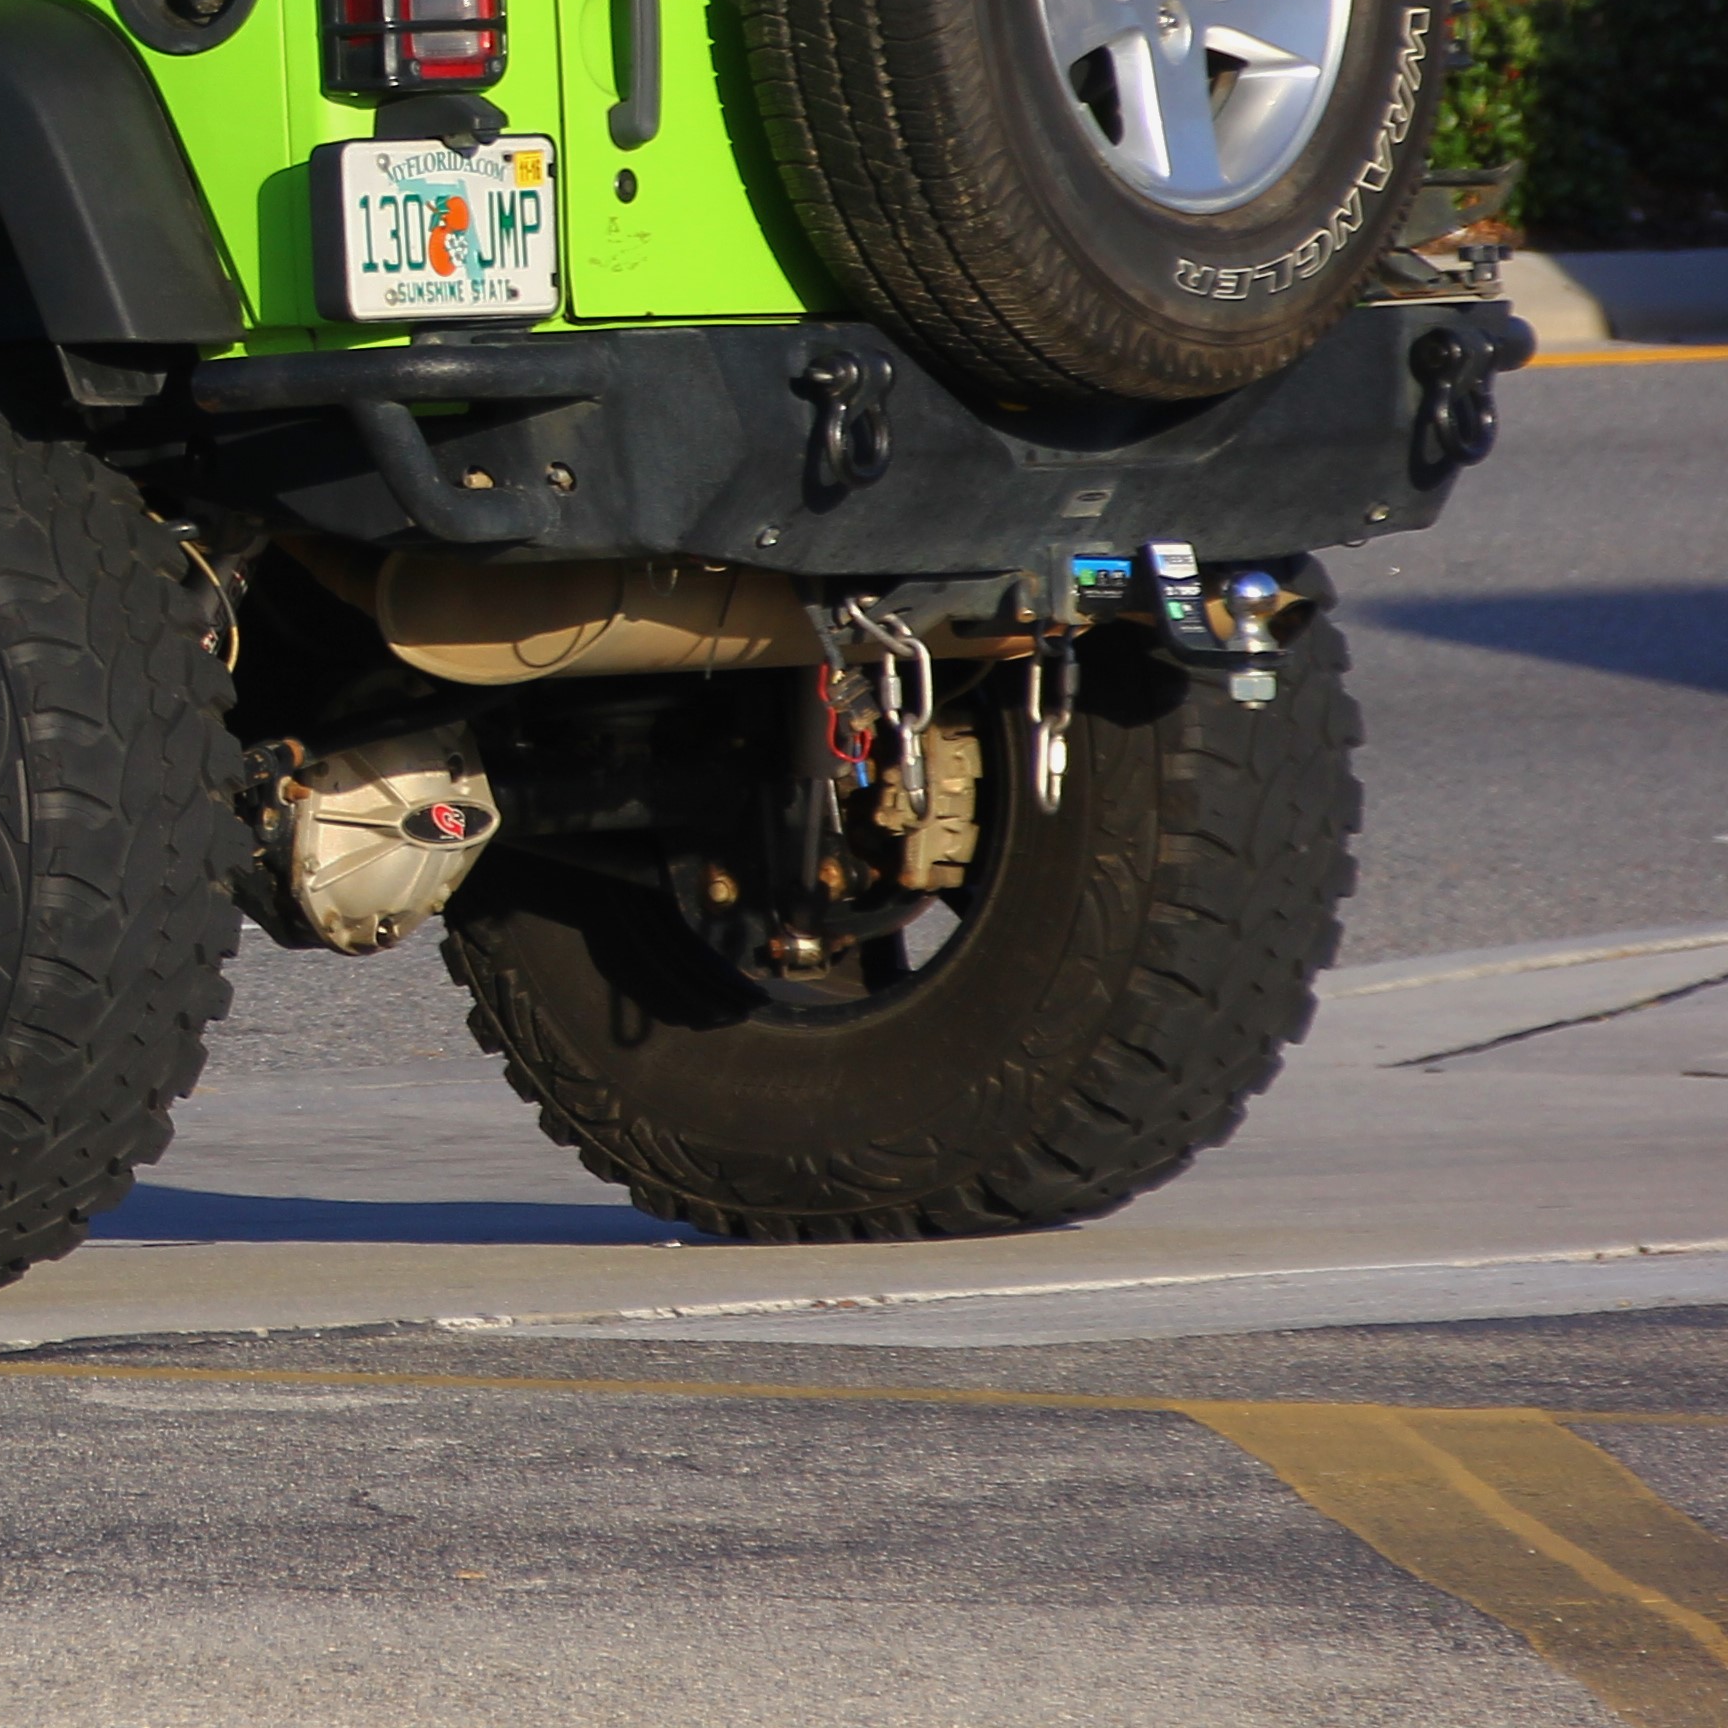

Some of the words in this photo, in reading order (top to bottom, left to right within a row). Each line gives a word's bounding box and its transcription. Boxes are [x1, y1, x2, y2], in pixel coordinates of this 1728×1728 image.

[1175, 6, 1430, 300] WRANGLER
[359, 193, 426, 272] 130
[476, 189, 542, 269] JMP
[397, 280, 464, 303] SUNSHINE
